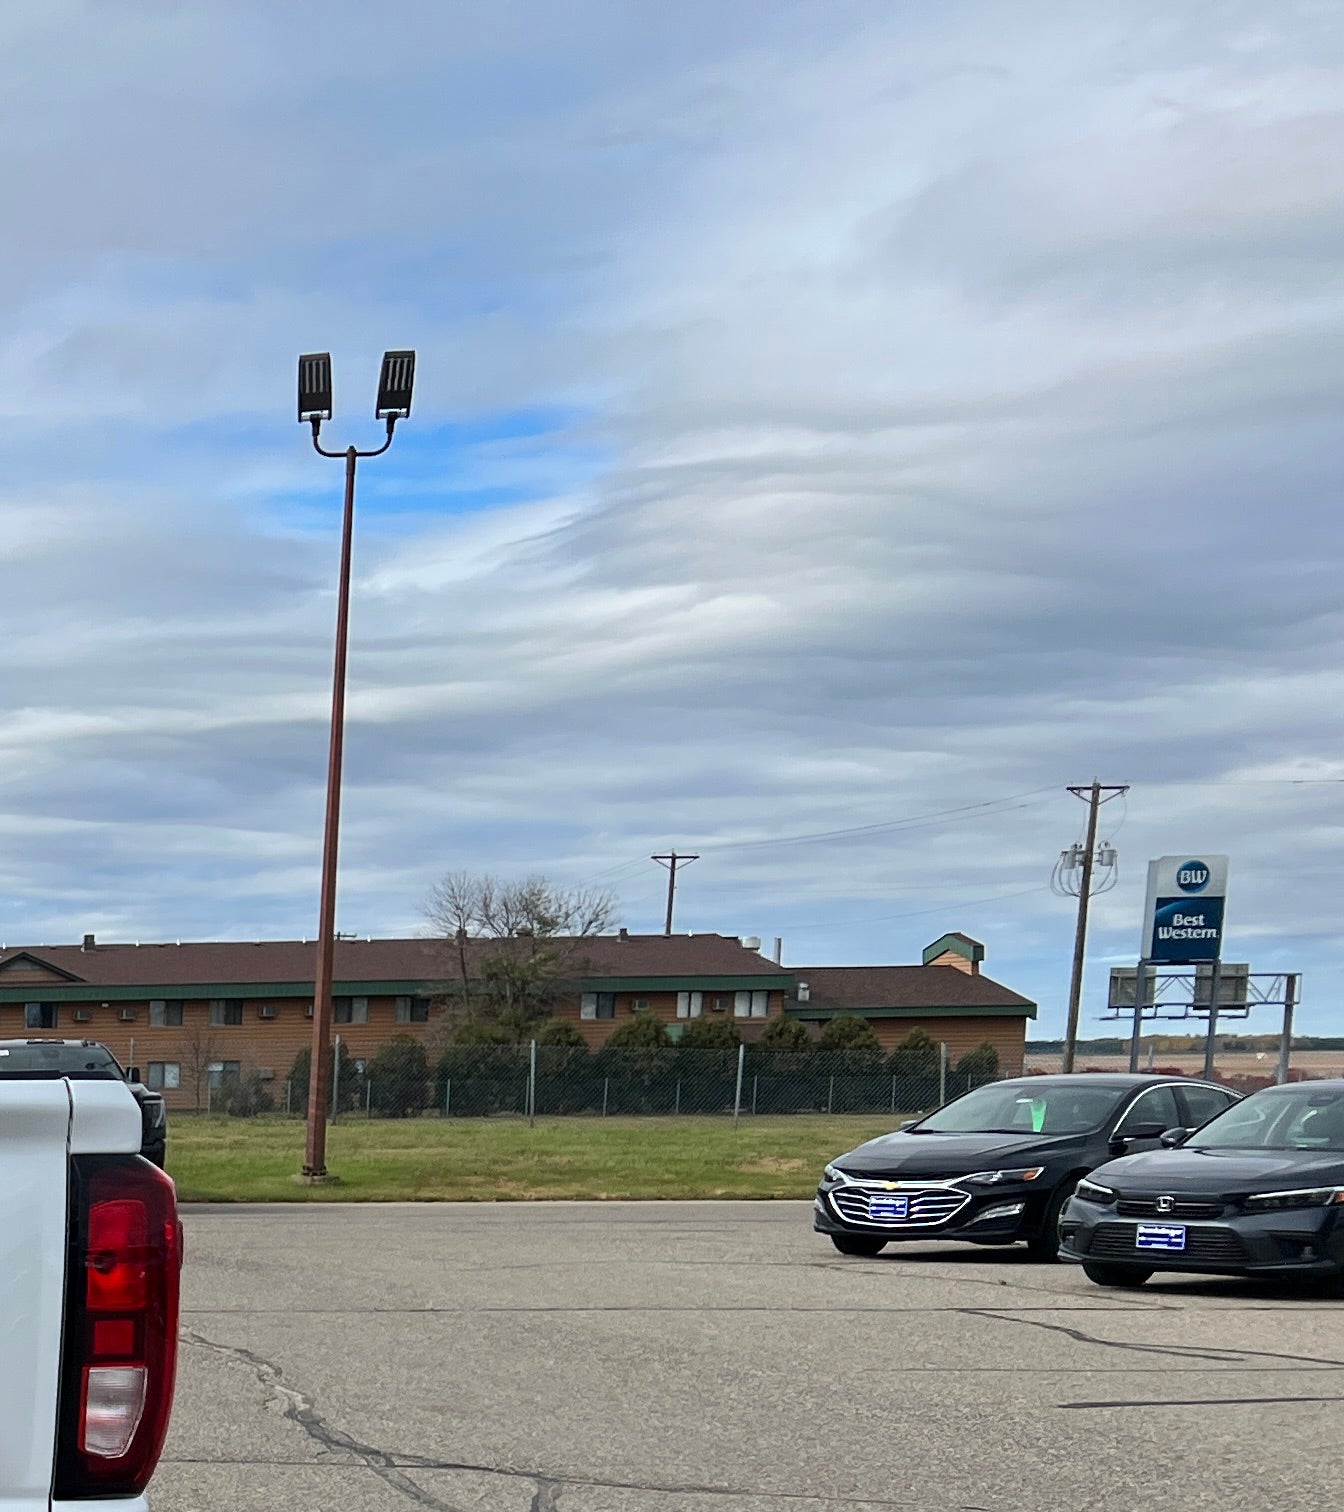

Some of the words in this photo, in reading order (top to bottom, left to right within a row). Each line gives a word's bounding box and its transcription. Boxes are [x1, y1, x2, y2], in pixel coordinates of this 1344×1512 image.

[1180, 870, 1208, 884] BW
[1172, 913, 1205, 926] Best
[1158, 926, 1217, 939] Western
